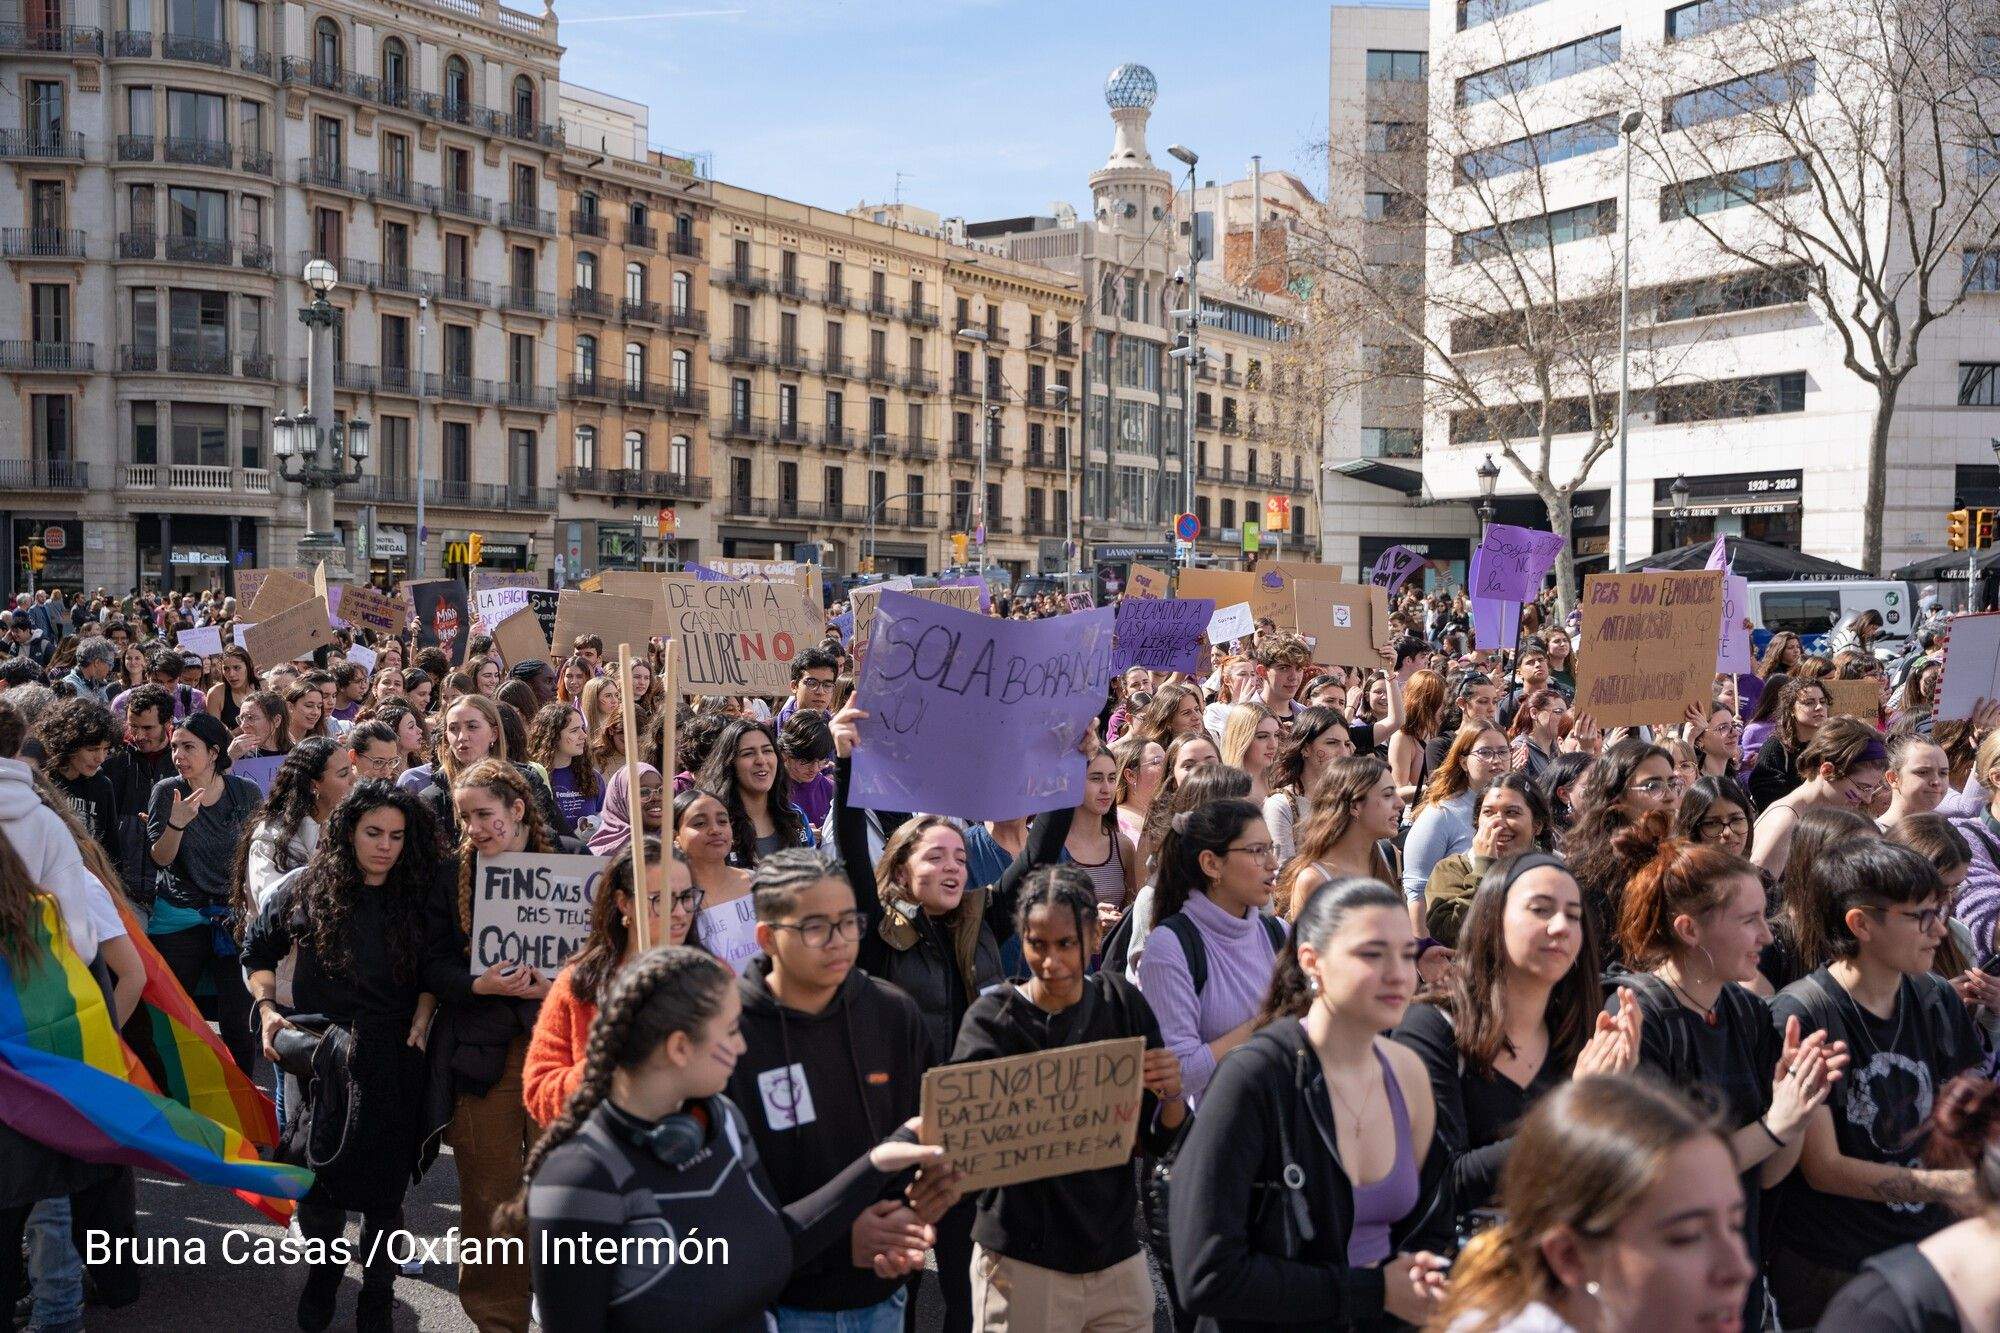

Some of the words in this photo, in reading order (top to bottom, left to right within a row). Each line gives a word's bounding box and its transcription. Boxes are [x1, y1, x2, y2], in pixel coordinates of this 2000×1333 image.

[668, 583, 700, 609] DE
[763, 584, 780, 609] A
[1591, 581, 1621, 605] PER
[1628, 583, 1657, 605] UN
[1190, 603, 1203, 621] A
[740, 630, 795, 662] NO
[878, 616, 996, 698] SOLA
